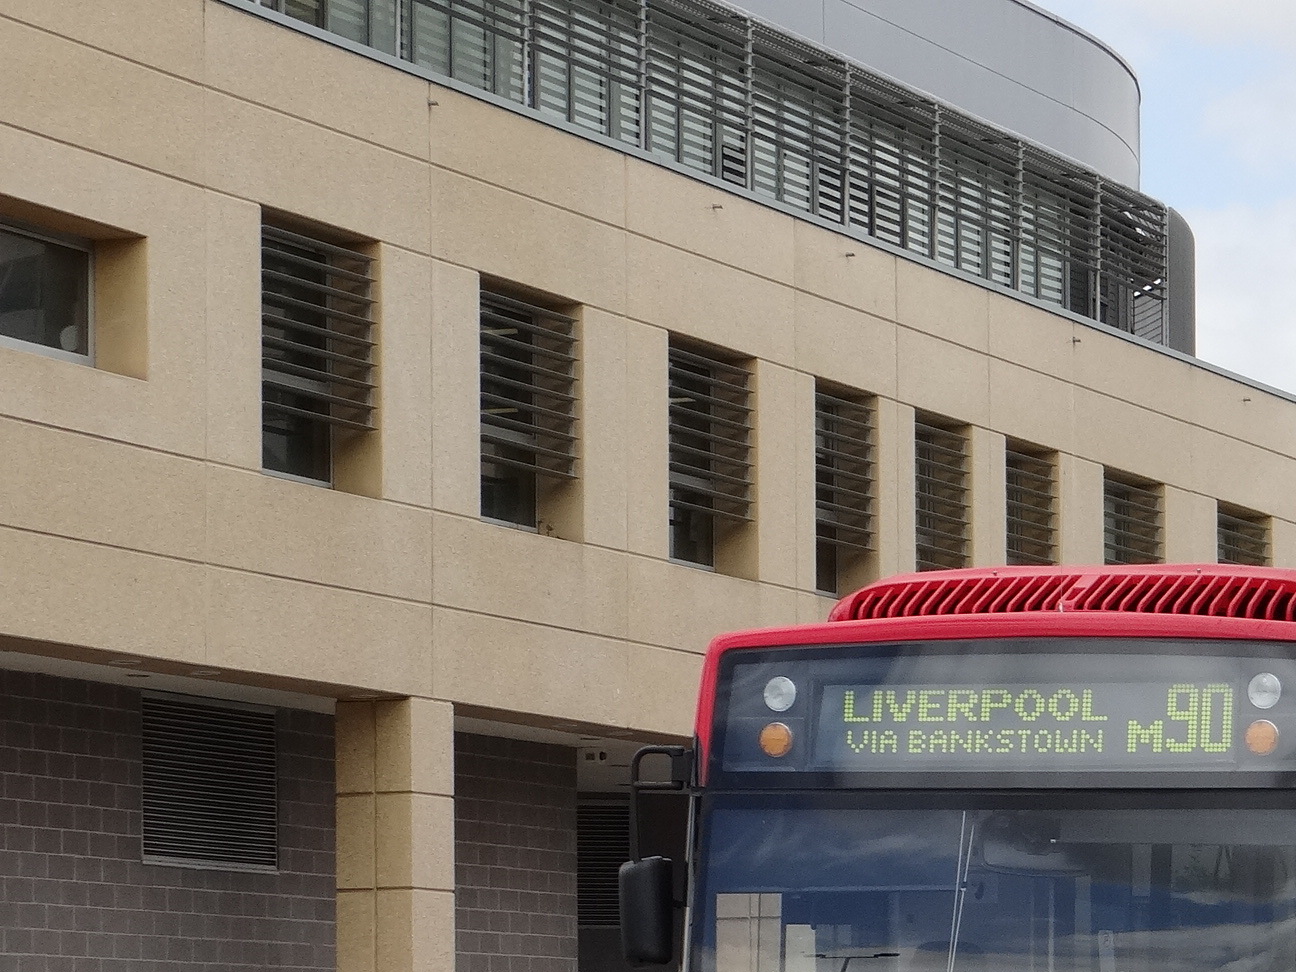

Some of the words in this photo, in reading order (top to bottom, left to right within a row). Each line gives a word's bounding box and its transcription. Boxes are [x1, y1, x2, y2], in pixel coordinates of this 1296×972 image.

[843, 689, 1108, 723] LIVERPOOL
[847, 729, 898, 754] VIA
[907, 729, 1104, 754] BANKSTOWN
